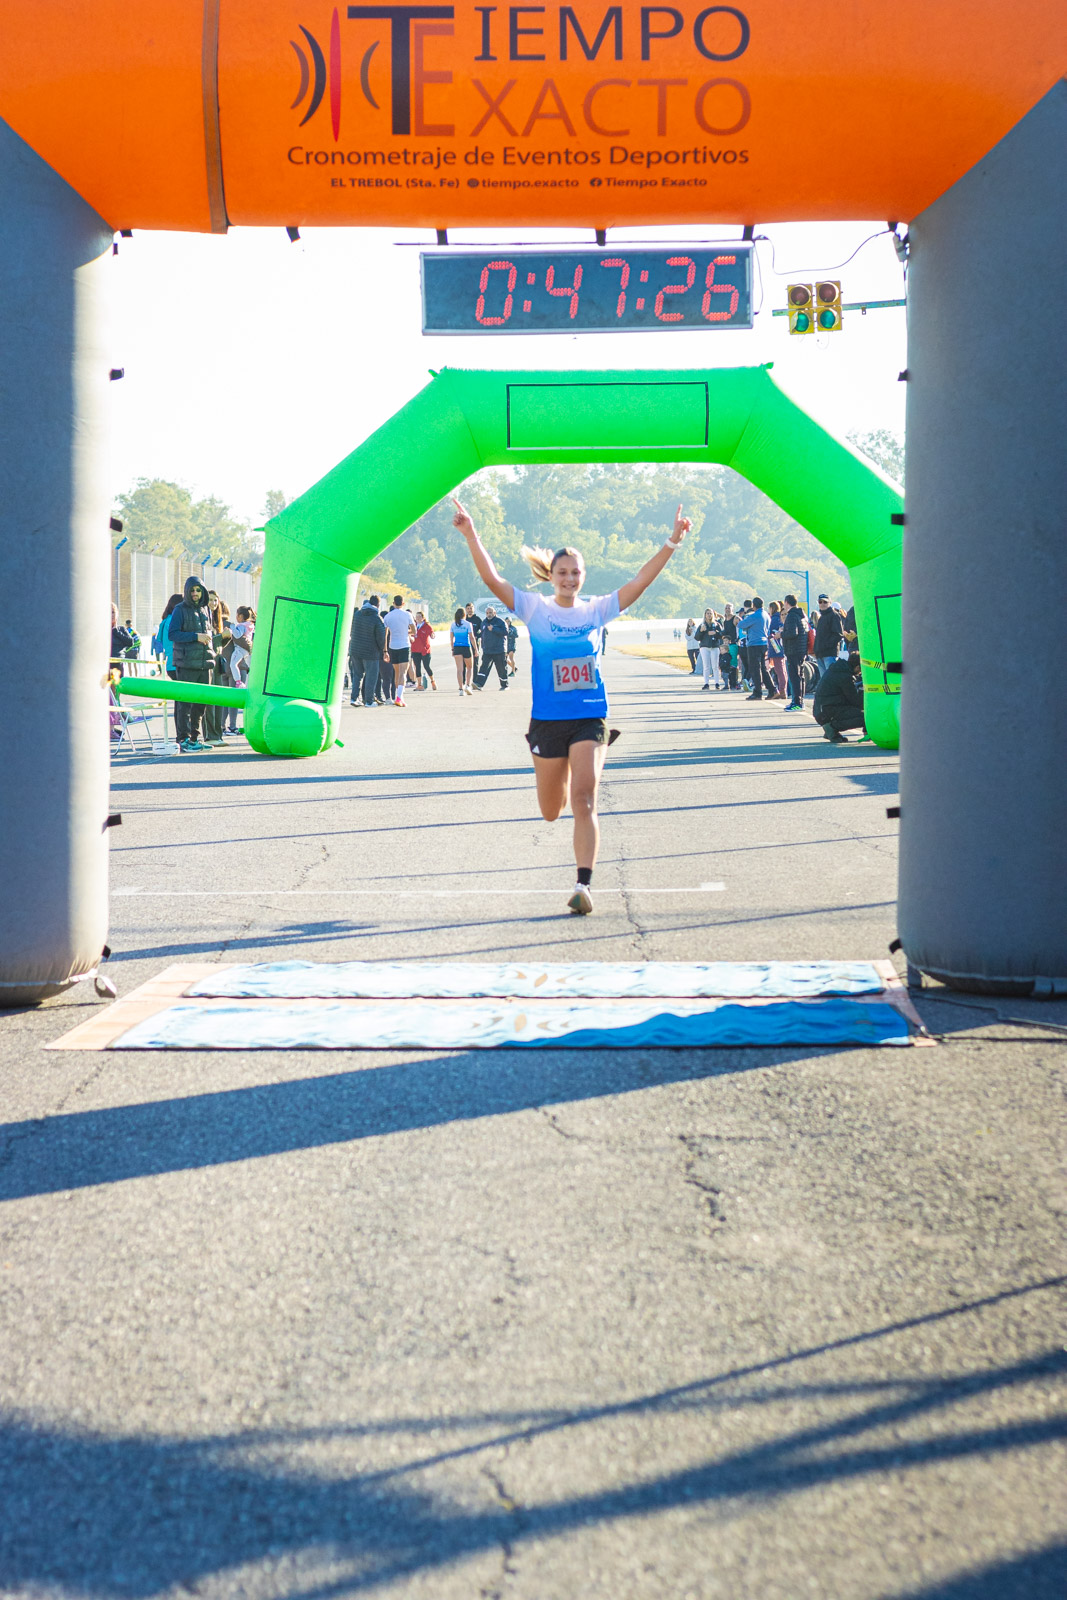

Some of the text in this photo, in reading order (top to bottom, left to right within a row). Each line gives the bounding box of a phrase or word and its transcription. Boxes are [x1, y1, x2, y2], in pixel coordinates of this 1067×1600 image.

[287, 146, 750, 169] Cronometraje de Eventos Deportivos
[330, 177, 460, 189] EL TREBOL (Sta. Fe)
[482, 177, 580, 190] tiempo.exacto
[605, 177, 708, 189] Tiempo Exacto
[475, 256, 739, 326] 0:47:26
[561, 664, 589, 684] 204
